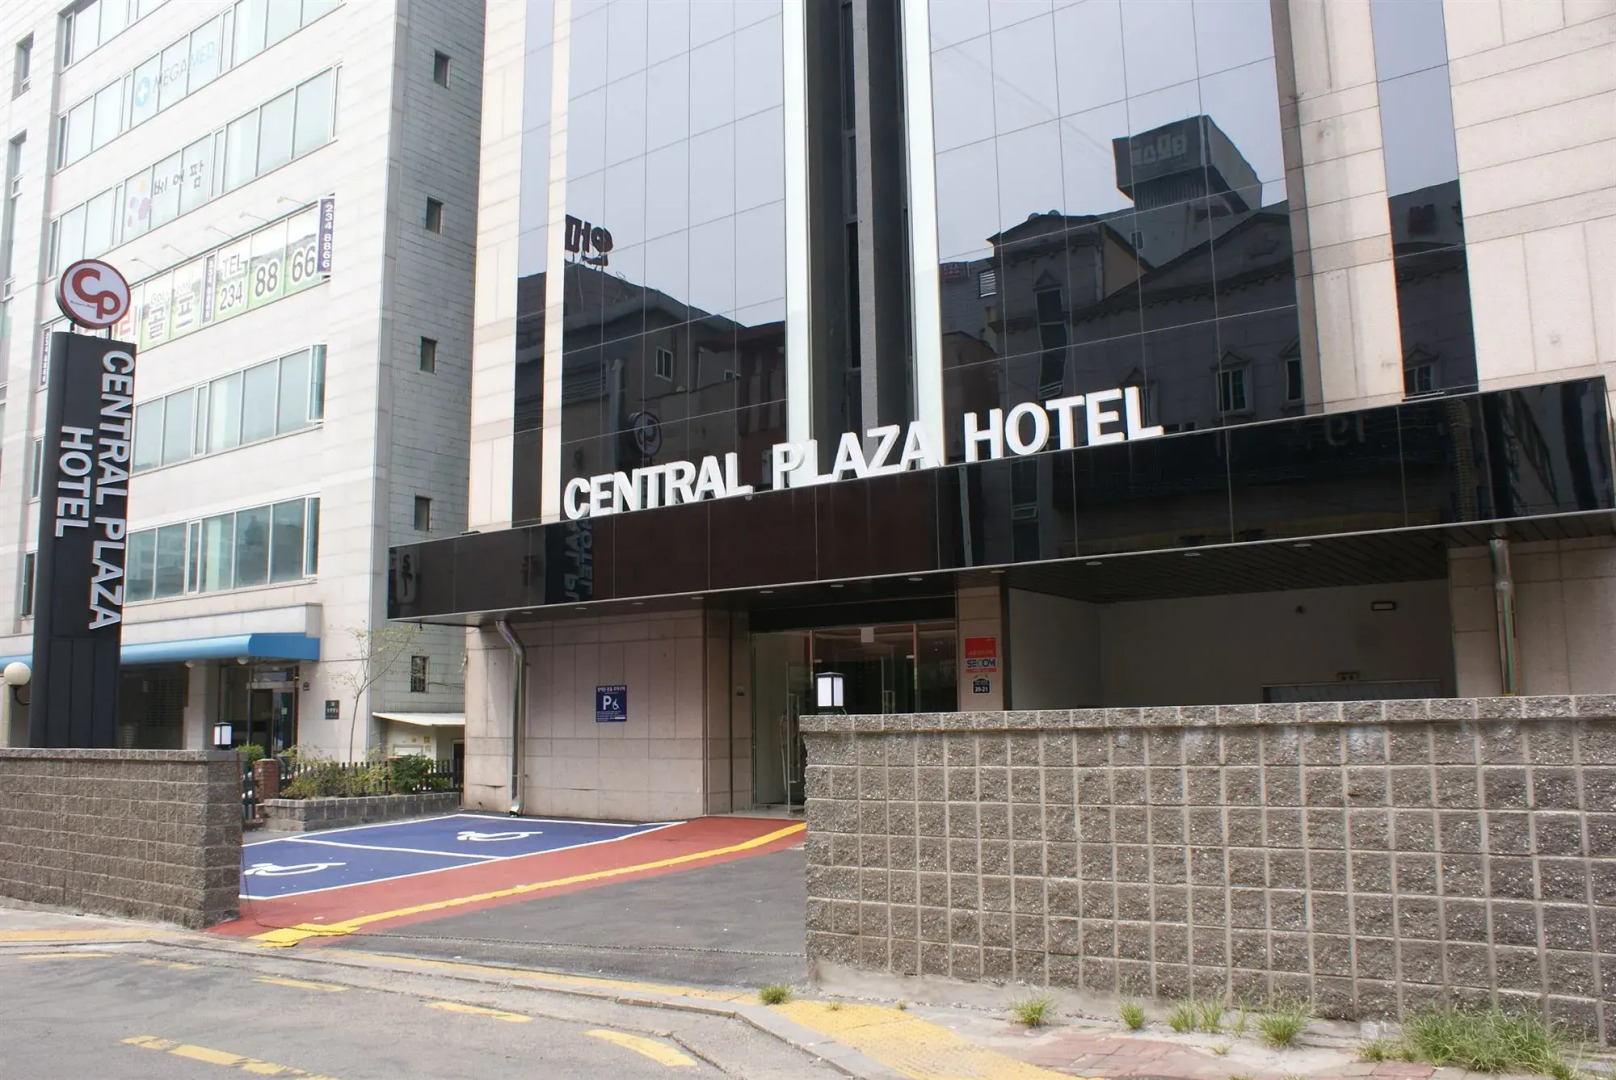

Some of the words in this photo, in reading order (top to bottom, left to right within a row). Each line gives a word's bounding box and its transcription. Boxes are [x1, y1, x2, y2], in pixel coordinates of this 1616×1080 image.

[219, 280, 243, 311] 234
[223, 253, 243, 278] TEL
[55, 425, 94, 538] HOTEL
[96, 350, 135, 505] CENTRAL
[563, 451, 754, 520] CENTRAL
[772, 420, 943, 491] PLAZA
[964, 385, 1165, 464] HOTEL
[88, 516, 126, 630] PLAZA
[602, 694, 612, 711] P
